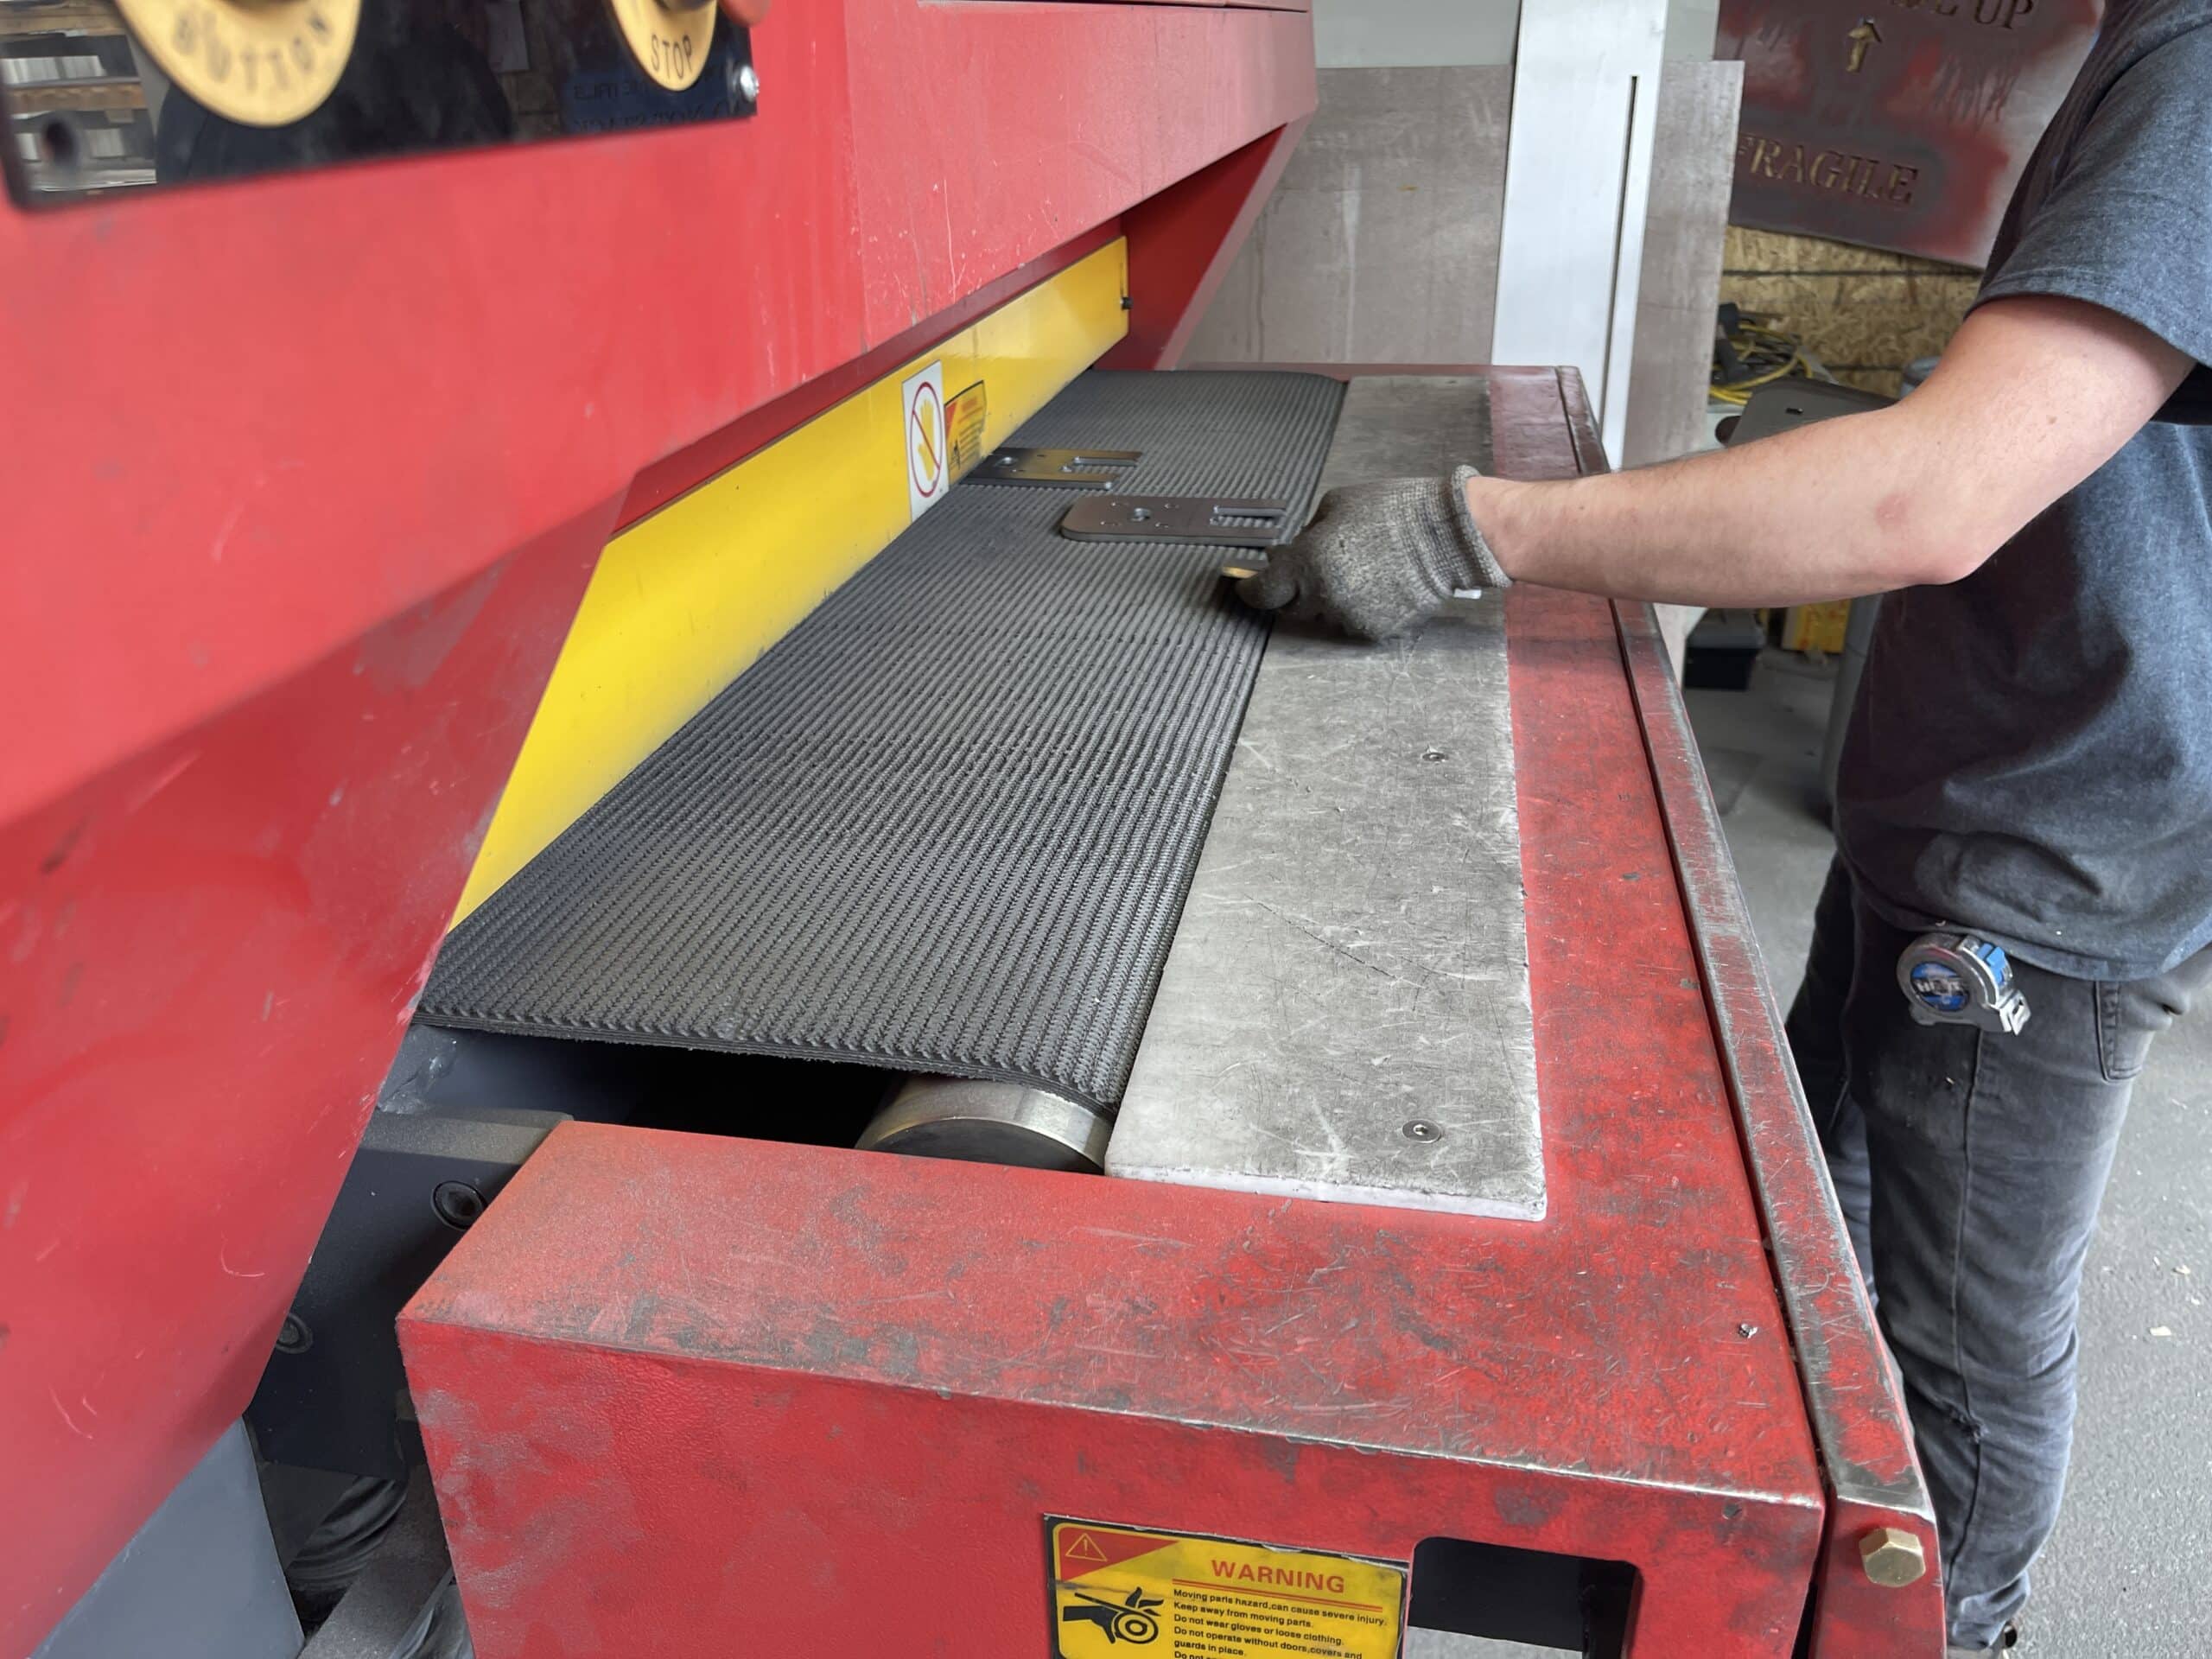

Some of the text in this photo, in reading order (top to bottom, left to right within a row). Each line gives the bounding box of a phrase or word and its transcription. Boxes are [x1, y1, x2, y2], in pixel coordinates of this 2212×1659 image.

[650, 34, 693, 80] STOP
[1211, 1559, 1345, 1593] WARNING
[1173, 1589, 1208, 1602] Moving
[1291, 1606, 1319, 1617] cause
[1322, 1610, 1355, 1621] severe
[1173, 1601, 1198, 1613] Keep
[1200, 1606, 1224, 1618] away
[1227, 1609, 1249, 1618] from
[1250, 1612, 1285, 1626] moving
[1173, 1614, 1187, 1623] Do
[1189, 1617, 1204, 1625] not
[1206, 1619, 1229, 1629] wear
[1231, 1623, 1262, 1634] gloves
[1275, 1628, 1301, 1639] loose
[1173, 1626, 1187, 1635] Do
[1189, 1629, 1204, 1637] not
[1205, 1631, 1243, 1643] operate
[1244, 1637, 1278, 1649] without
[1173, 1640, 1206, 1650] guards
[1173, 1650, 1187, 1659] Do
